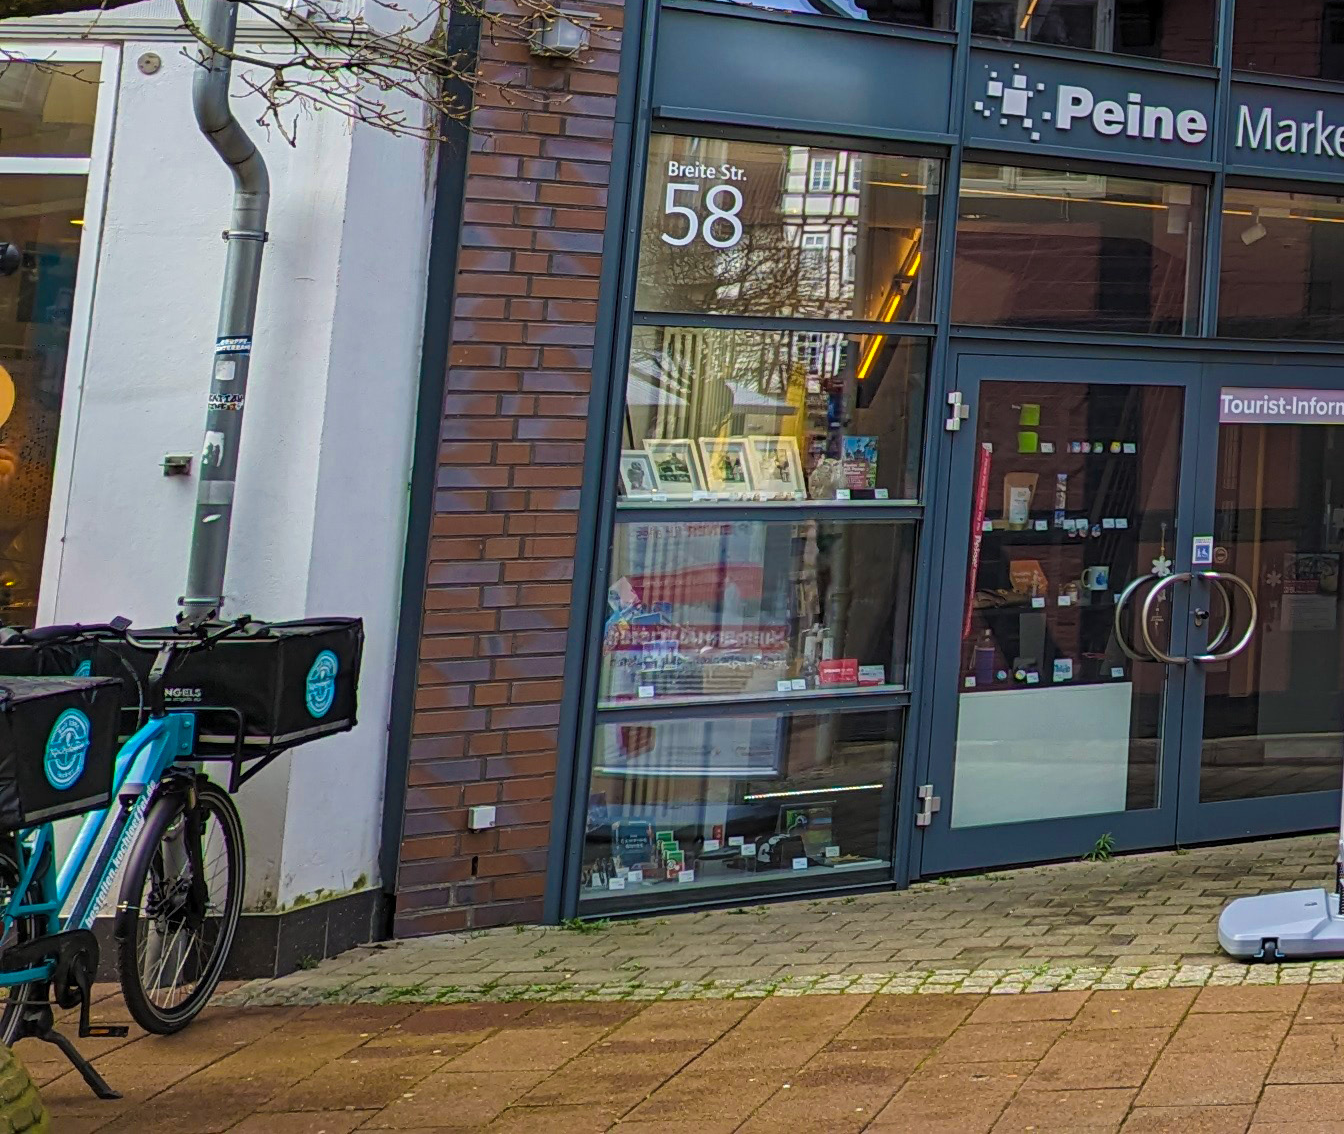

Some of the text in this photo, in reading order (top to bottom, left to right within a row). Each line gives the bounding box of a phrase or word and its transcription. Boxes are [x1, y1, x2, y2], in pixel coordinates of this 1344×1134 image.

[1055, 84, 1208, 144] Peine
[668, 160, 748, 182] Breite Str.
[661, 182, 744, 249] 58
[163, 687, 202, 698] NGELS
